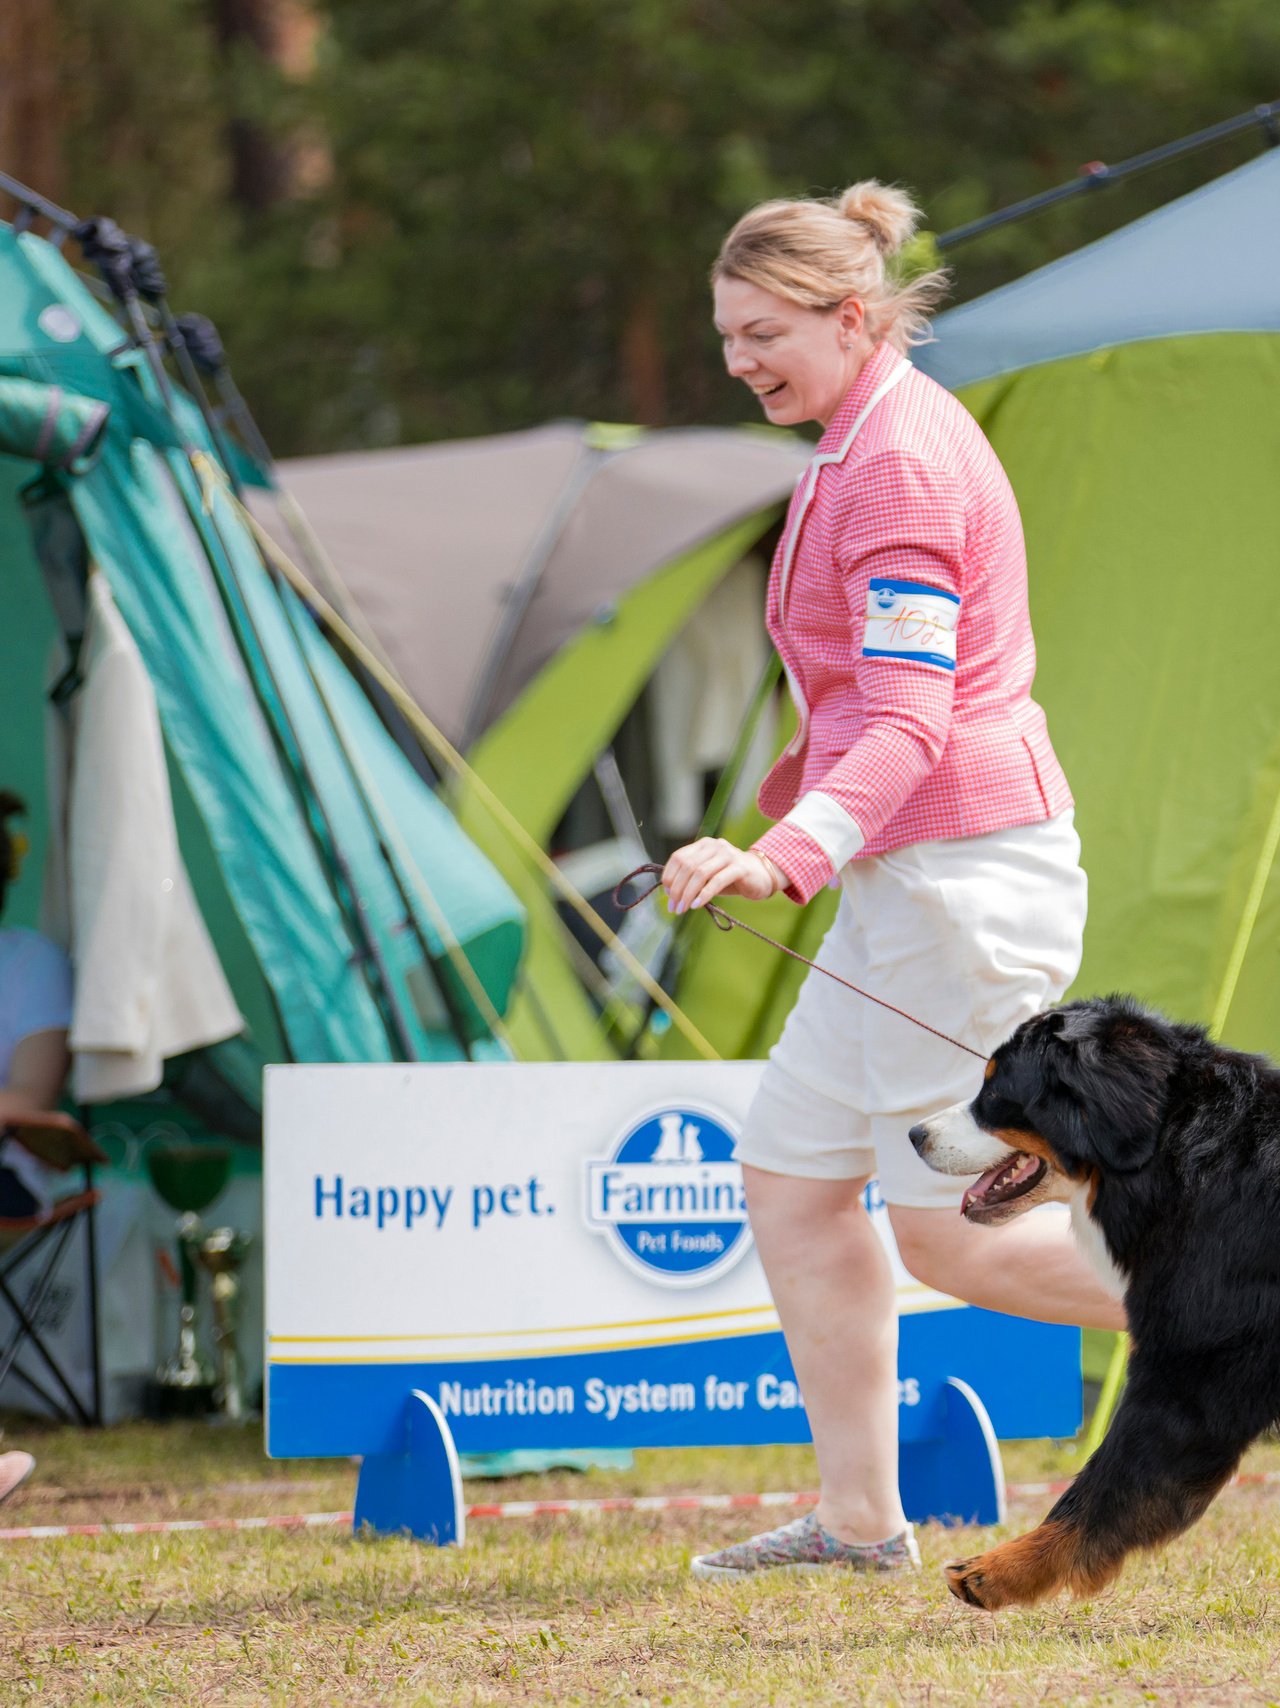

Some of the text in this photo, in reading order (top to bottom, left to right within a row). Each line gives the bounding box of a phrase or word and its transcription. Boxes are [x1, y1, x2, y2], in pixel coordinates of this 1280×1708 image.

[883, 606, 944, 645] 102
[314, 1175, 555, 1230] Happy pet.
[637, 1230, 724, 1254] Pet Foods
[439, 1378, 575, 1416] Nutrition
[584, 1377, 695, 1420] System
[704, 1374, 749, 1411] for
